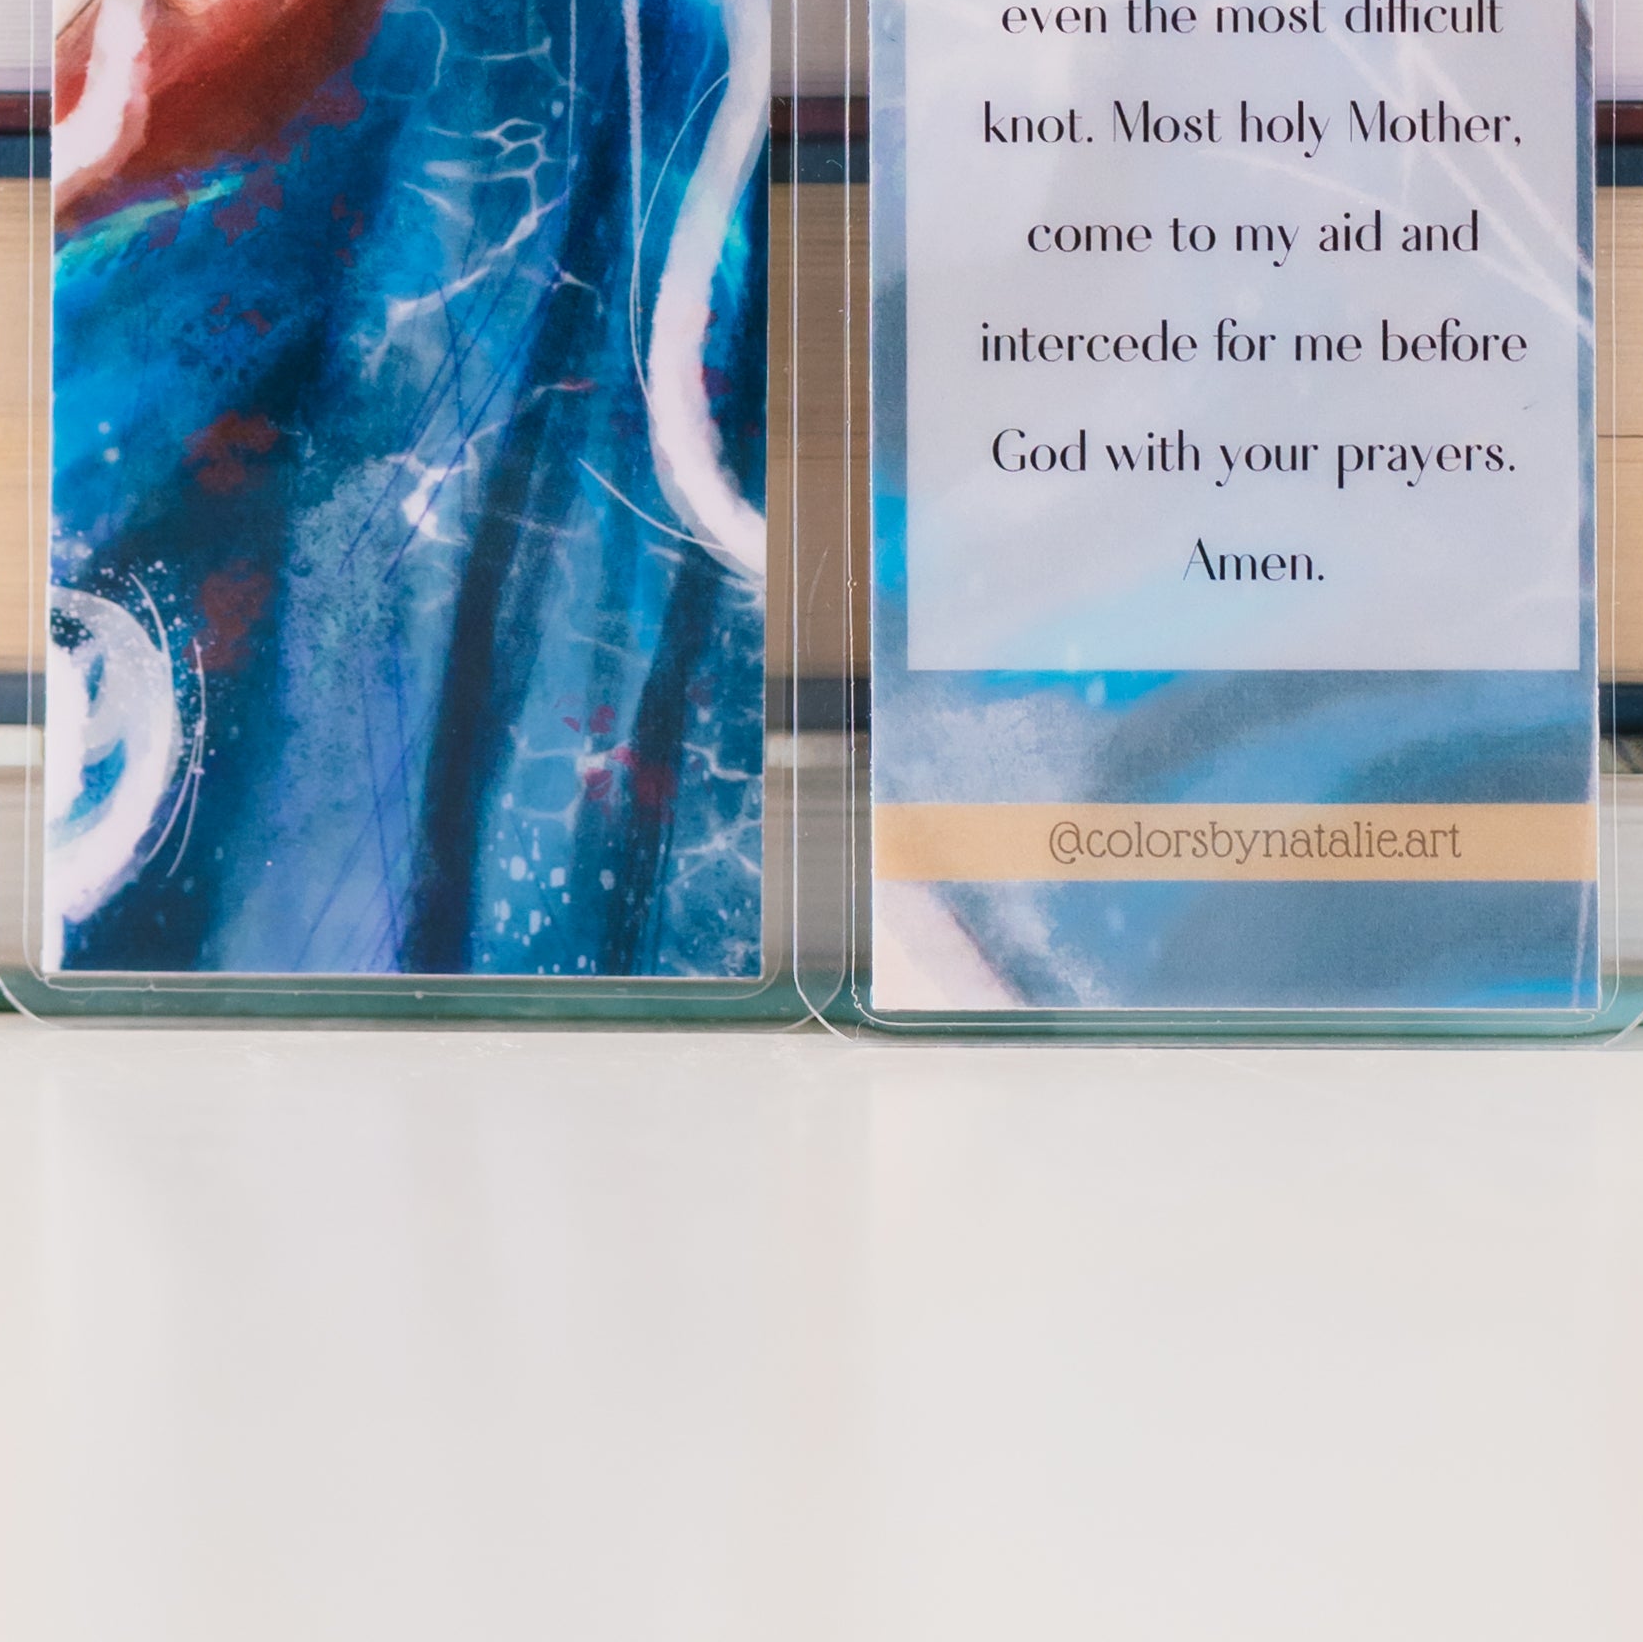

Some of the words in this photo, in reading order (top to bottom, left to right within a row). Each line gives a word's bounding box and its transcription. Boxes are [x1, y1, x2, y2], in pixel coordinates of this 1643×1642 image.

[1000, 5, 1108, 35] even
[983, 99, 1095, 145] knot.
[1112, 98, 1223, 145] Most
[1239, 98, 1330, 160] holy
[1348, 98, 1523, 148] Mother,
[1026, 223, 1154, 254] come
[1167, 216, 1218, 254] to
[1234, 223, 1300, 269] my
[1317, 208, 1383, 254] aid
[1400, 207, 1480, 254] and
[980, 317, 1199, 364] intercede
[1212, 316, 1278, 363] for
[1293, 333, 1364, 363] me
[1380, 316, 1529, 363] before
[990, 427, 1088, 474] God
[1104, 427, 1202, 473] with
[1214, 443, 1320, 489] your
[1336, 442, 1517, 491] prayers.
[1183, 536, 1326, 583] Amen.
[1047, 818, 1464, 867] @colorsbynatalie.art
